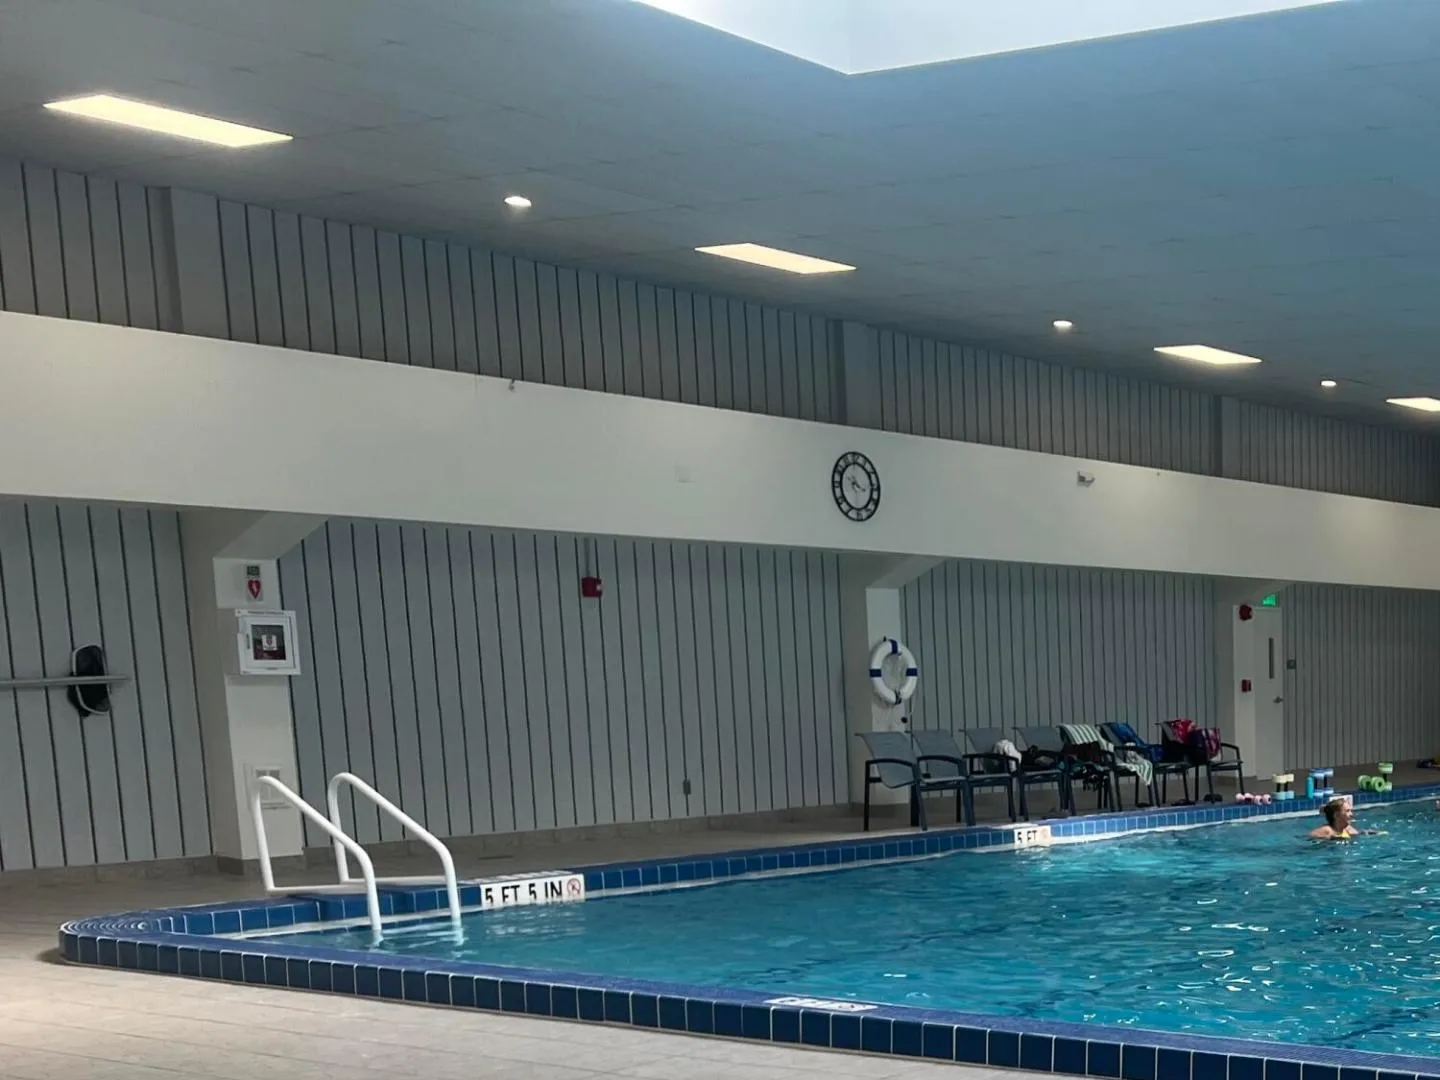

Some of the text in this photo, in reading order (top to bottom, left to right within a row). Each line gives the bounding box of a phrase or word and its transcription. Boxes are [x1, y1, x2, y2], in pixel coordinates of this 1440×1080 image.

[1017, 830, 1037, 844] 5 FT
[485, 880, 563, 905] 5 FT 5 IN
